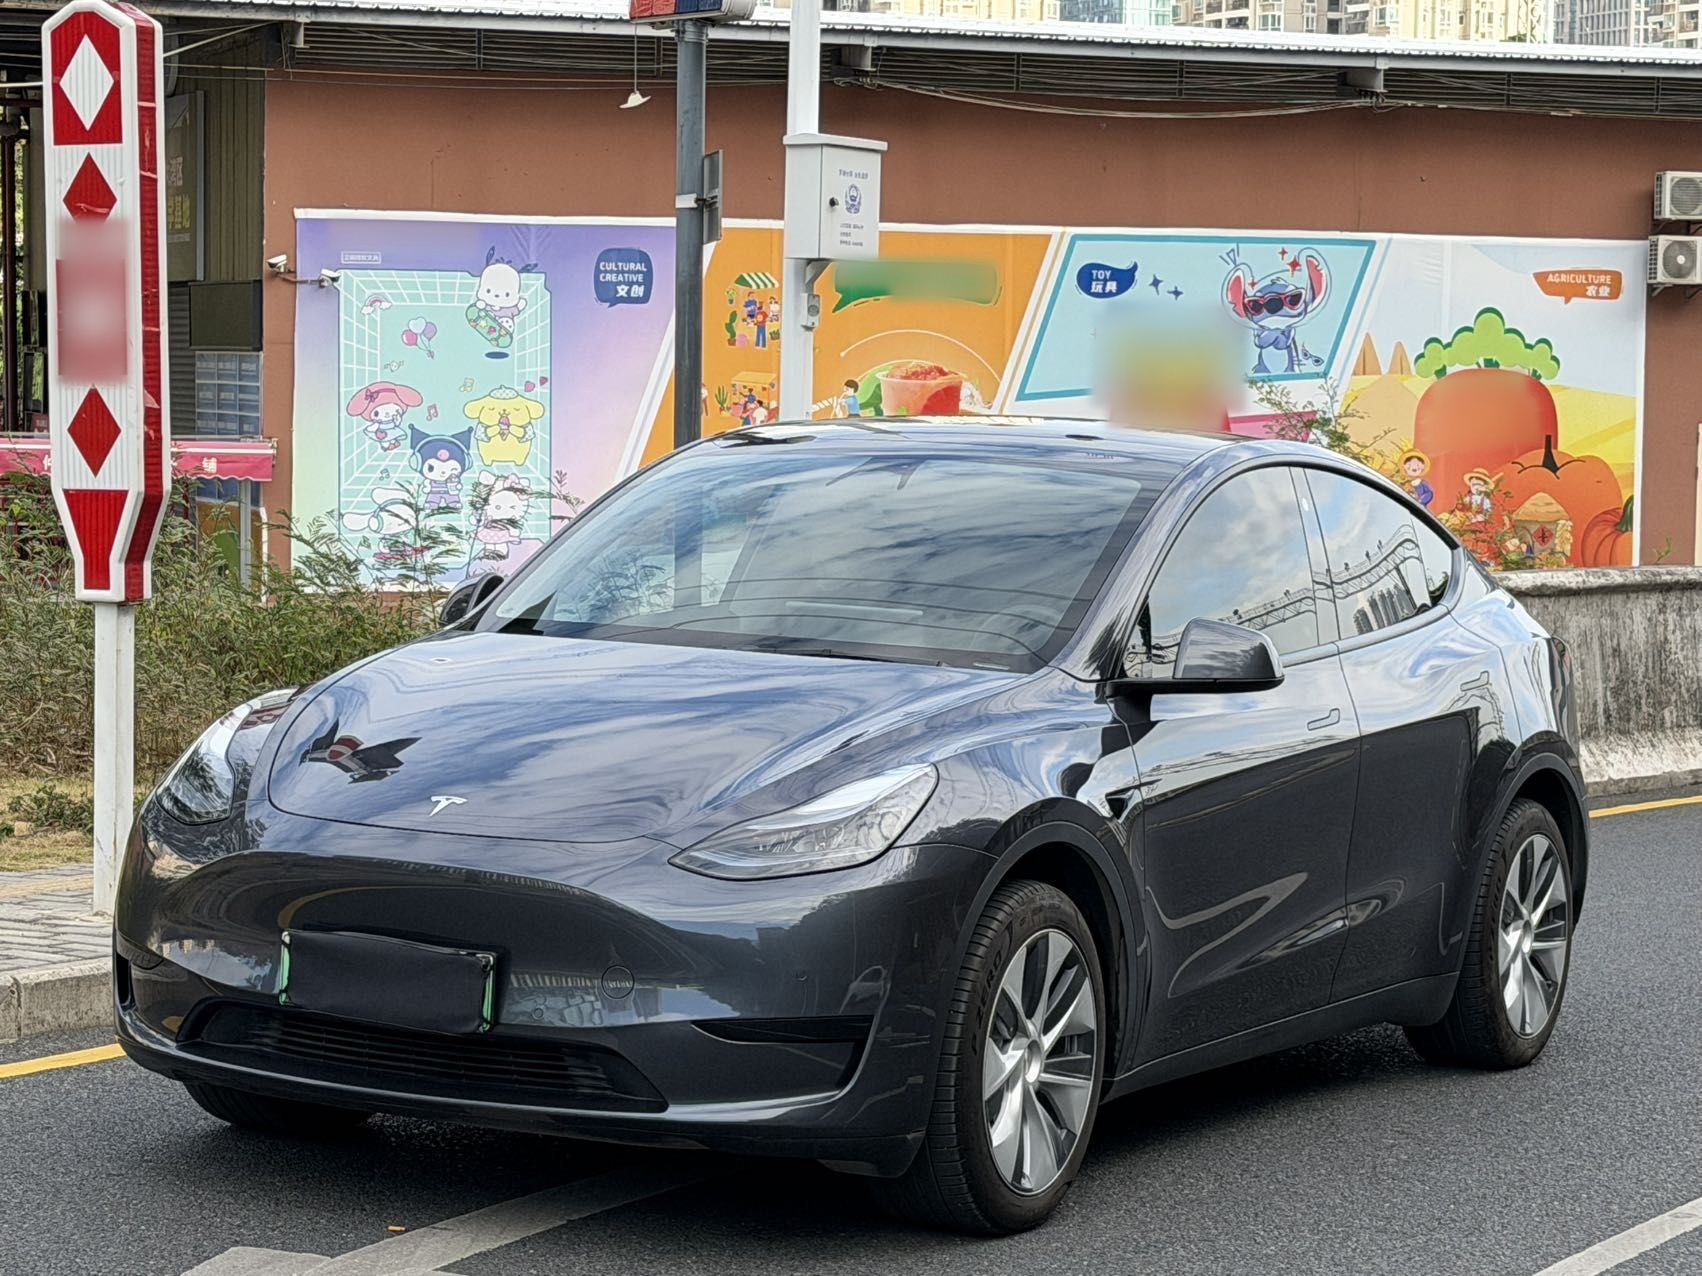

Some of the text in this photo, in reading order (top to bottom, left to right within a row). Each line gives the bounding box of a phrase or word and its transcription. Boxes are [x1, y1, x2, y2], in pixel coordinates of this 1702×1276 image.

[599, 261, 648, 272] CULTURAL
[599, 273, 645, 283] CREATIVE
[1091, 269, 1112, 280] TOY
[1546, 273, 1612, 285] AGRICULTURE
[615, 284, 646, 298] 文创
[1090, 281, 1118, 294] 玩具
[1585, 285, 1611, 297] 农业
